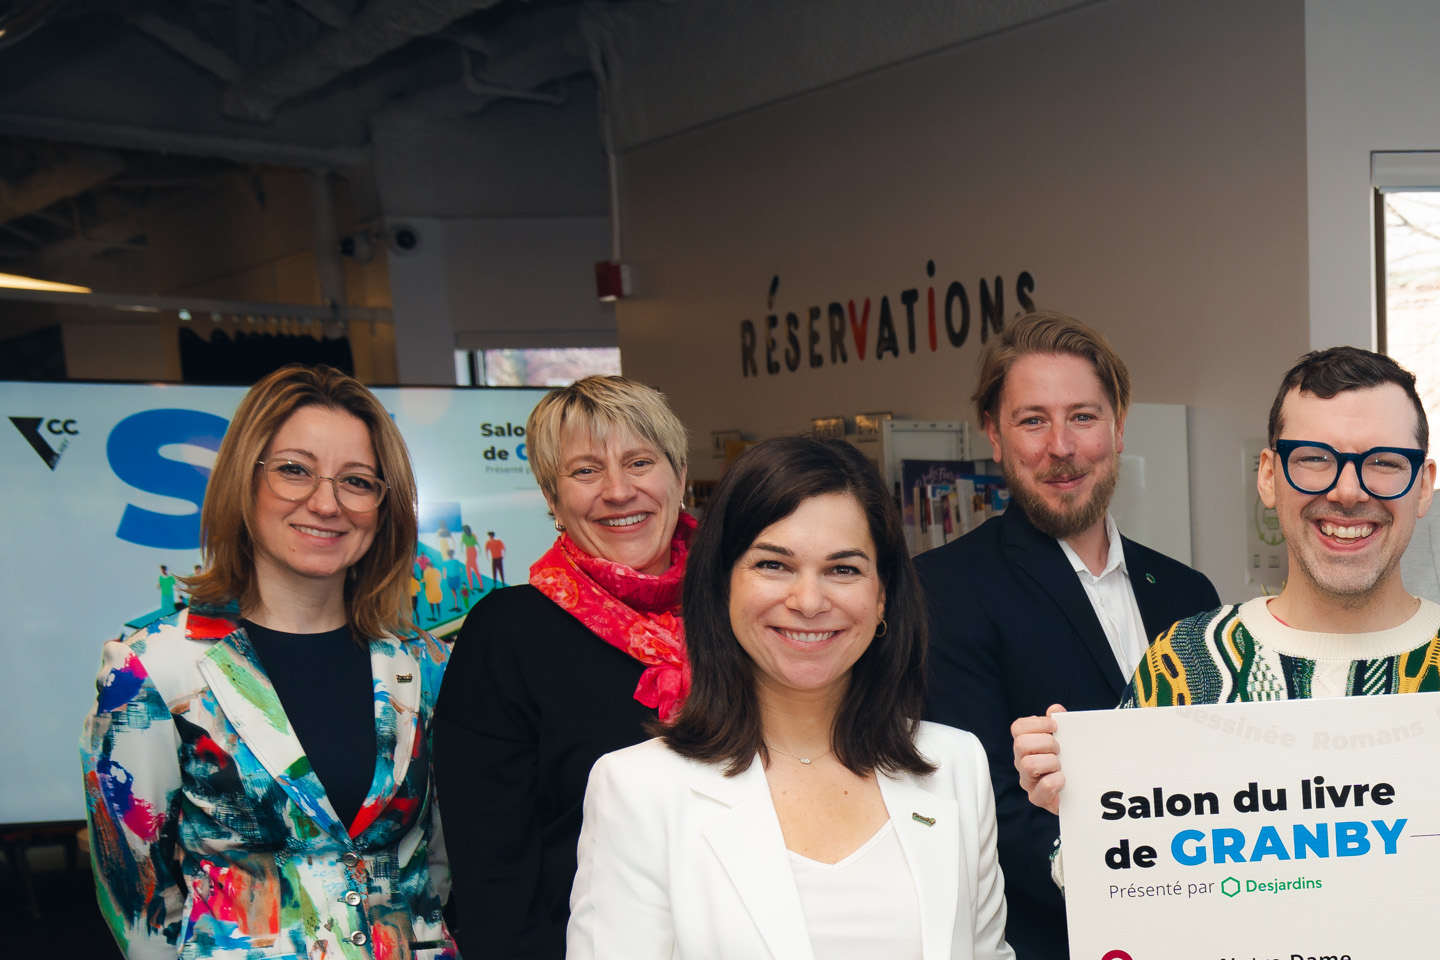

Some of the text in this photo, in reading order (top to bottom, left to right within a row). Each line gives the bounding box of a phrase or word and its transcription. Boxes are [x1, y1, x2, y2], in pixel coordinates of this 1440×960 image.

[740, 259, 1036, 378] RÉSERVATIONS
[483, 447, 509, 460] de
[485, 466, 525, 474] Présenté
[1101, 776, 1395, 820] Salon du livre
[1105, 819, 1407, 869] de GRANBY
[1110, 877, 1322, 898] Présenté par Desjardins
